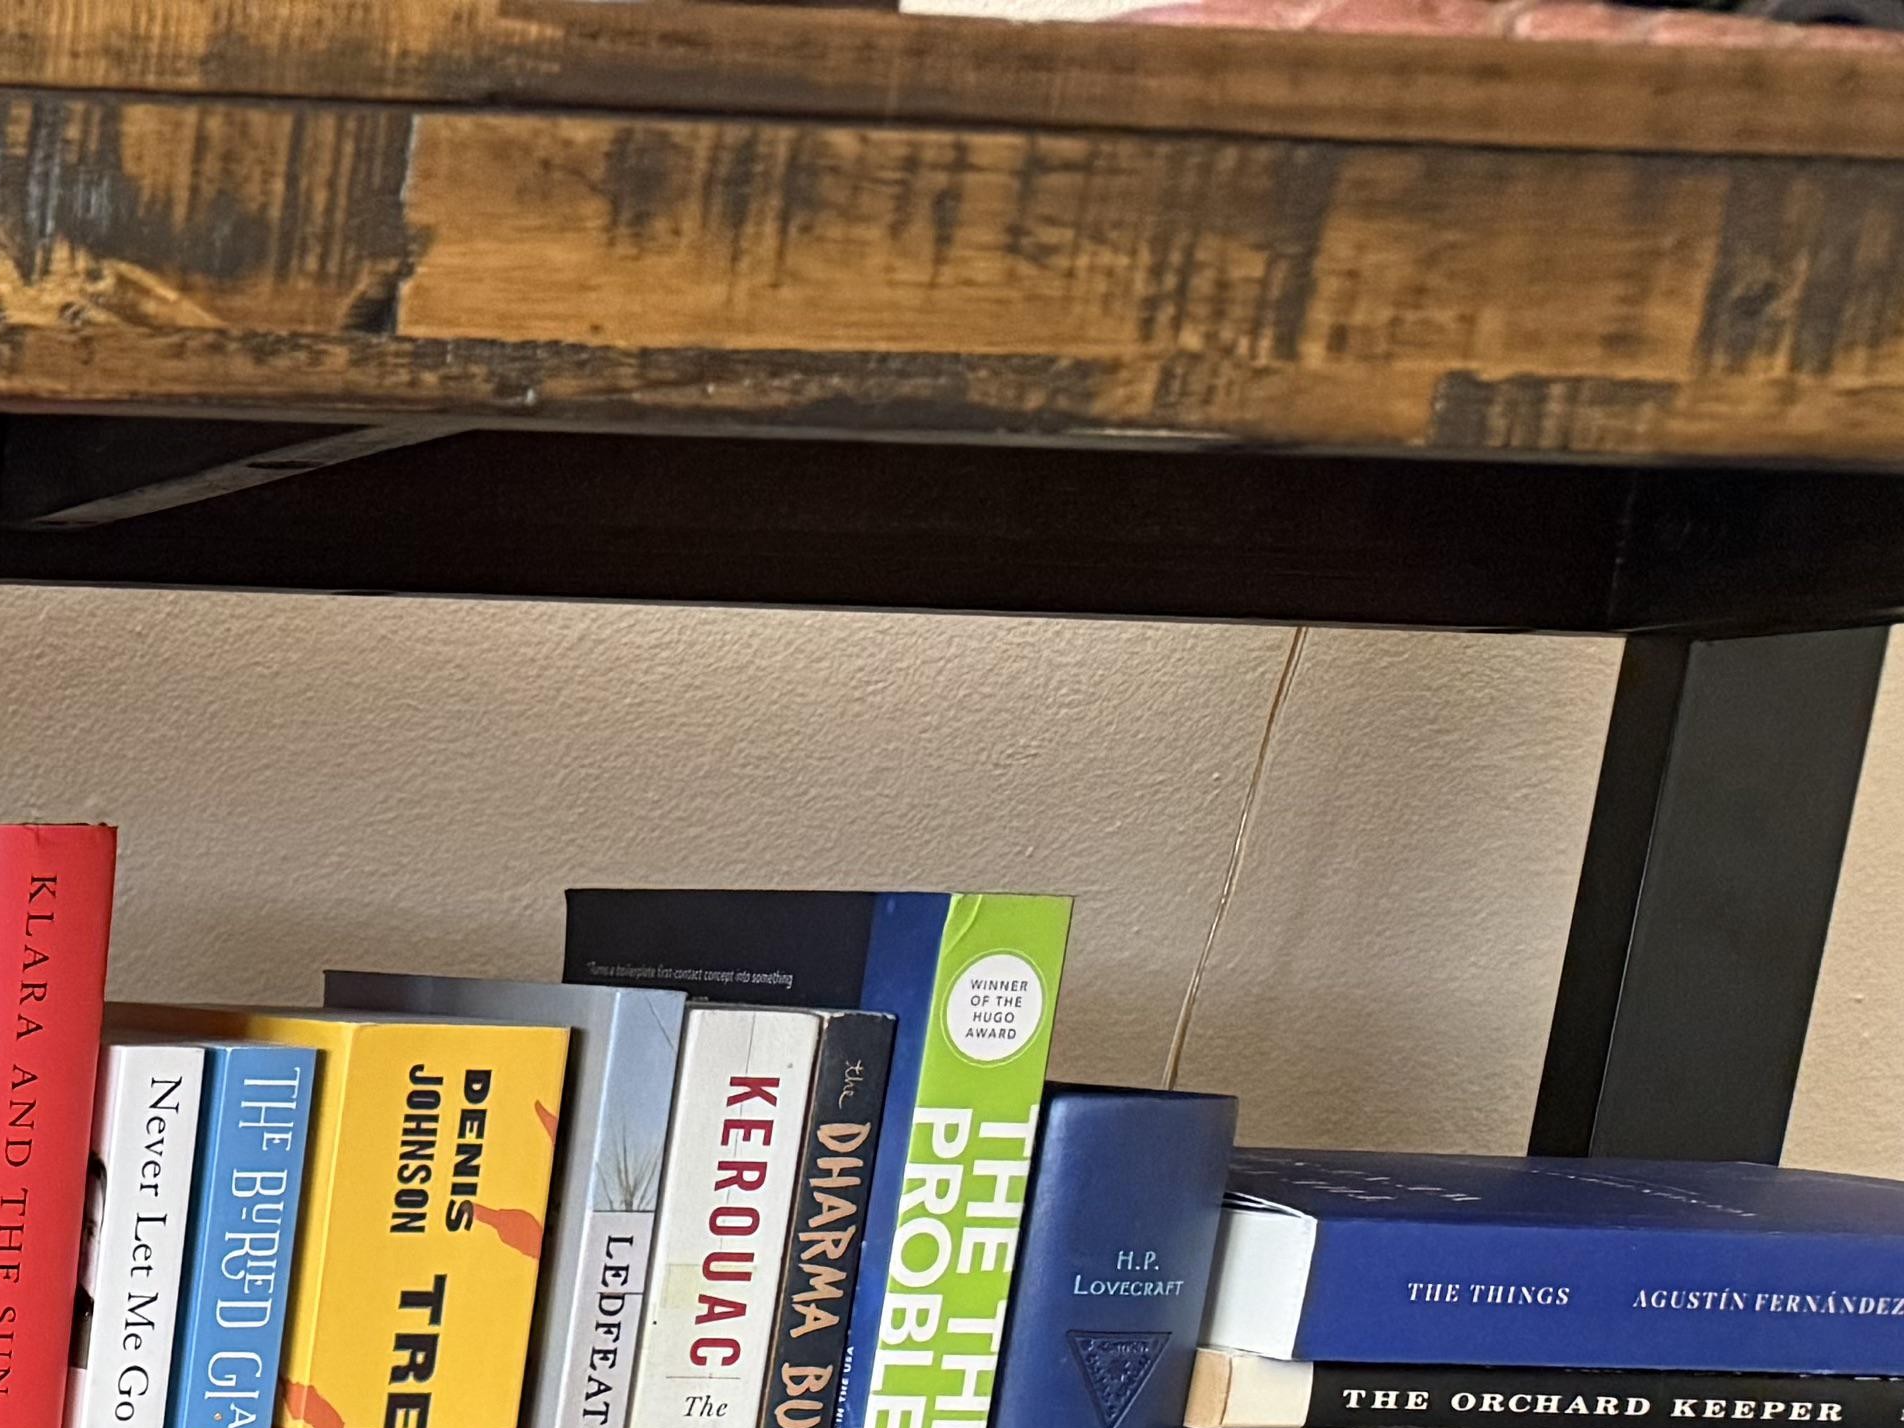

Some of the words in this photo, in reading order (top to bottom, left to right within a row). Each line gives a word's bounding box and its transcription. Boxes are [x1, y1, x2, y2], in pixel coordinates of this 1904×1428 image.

[16, 874, 58, 1041] KLARA
[970, 979, 1028, 993] WINNER
[971, 995, 990, 1008] OF
[995, 995, 1023, 1008] THE
[972, 1011, 1015, 1024] HUGO
[965, 1028, 1017, 1041] AWARD
[6, 1064, 40, 1169] AND
[688, 1075, 782, 1369] KEROUAC
[1116, 1251, 1160, 1271] H.P.
[1072, 1275, 1184, 1296] LOVECRAFT
[683, 1395, 730, 1419] The
[1343, 1388, 1431, 1411] THE
[1451, 1391, 1651, 1416] ORCHARD
[1670, 1396, 1843, 1422] KEEPER
